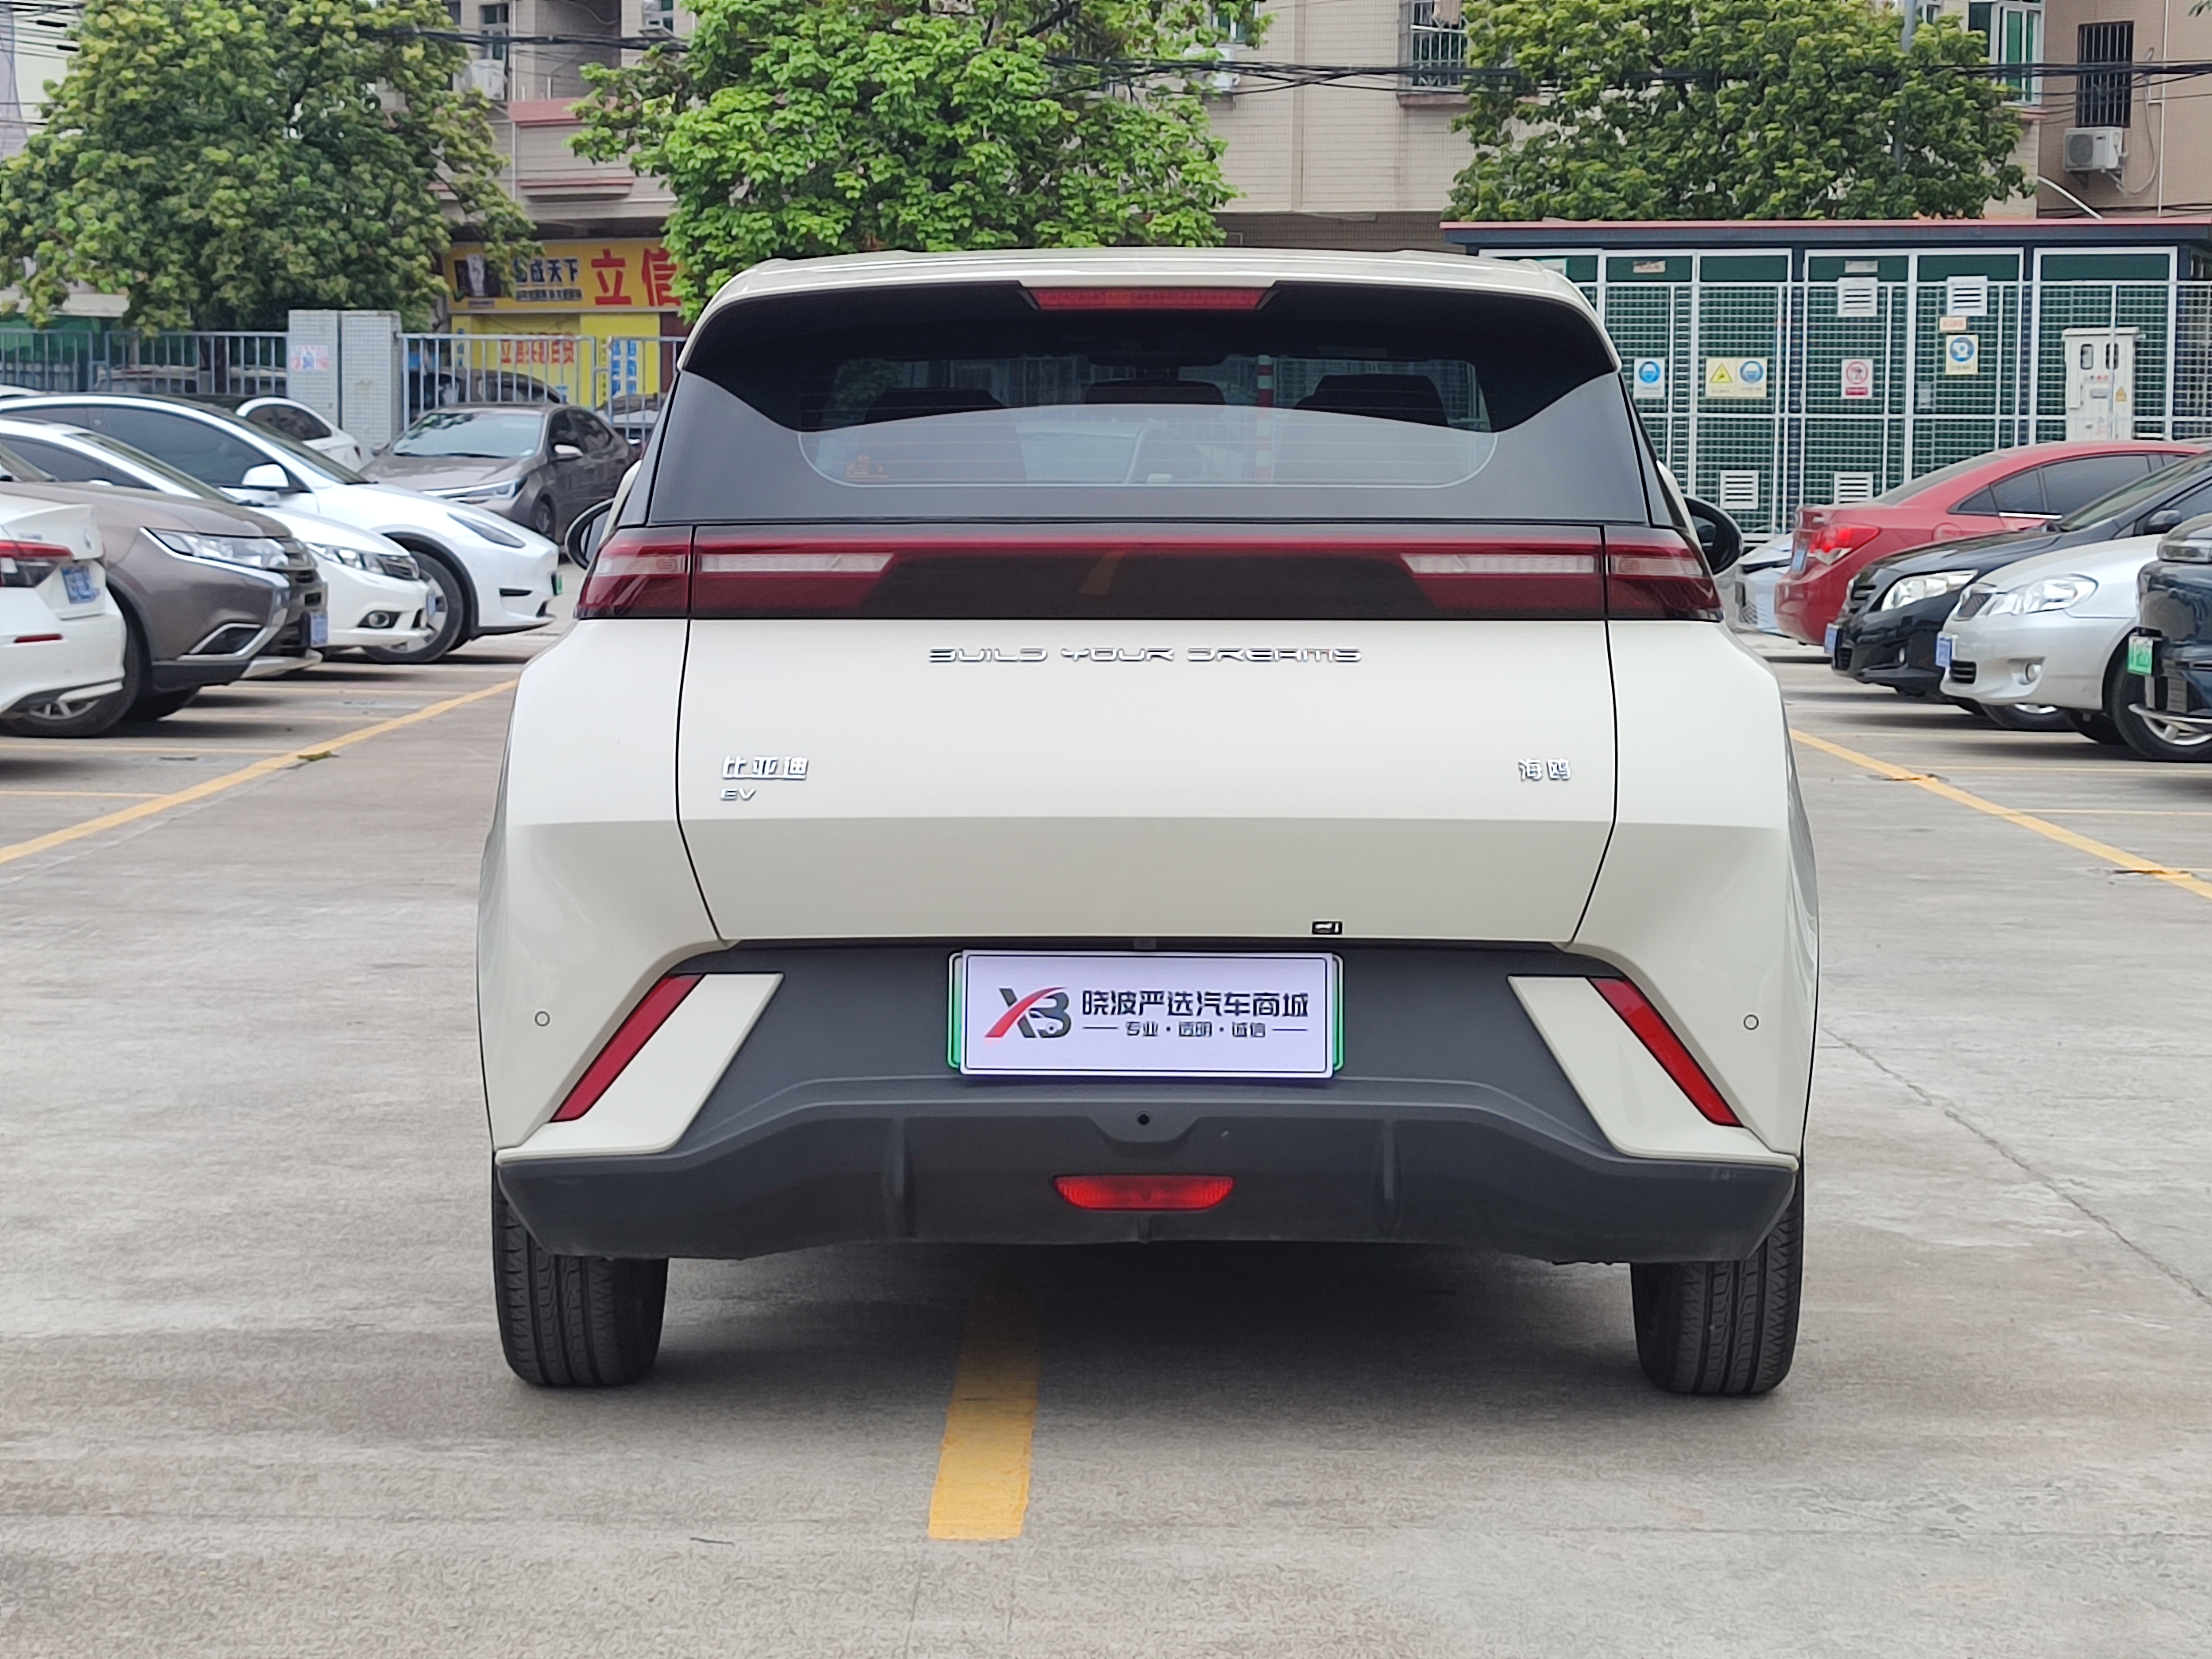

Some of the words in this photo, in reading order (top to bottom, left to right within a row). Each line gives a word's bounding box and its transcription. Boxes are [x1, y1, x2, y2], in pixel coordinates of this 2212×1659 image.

[928, 647, 1048, 663] BUILD
[1061, 647, 1175, 663] YOUR
[1187, 647, 1362, 663] DREAMS
[721, 755, 808, 780] 比亚迪
[1518, 758, 1571, 781] 海鸥
[720, 788, 756, 800] EV
[1082, 990, 1308, 1017] 晓波严选汽车商城
